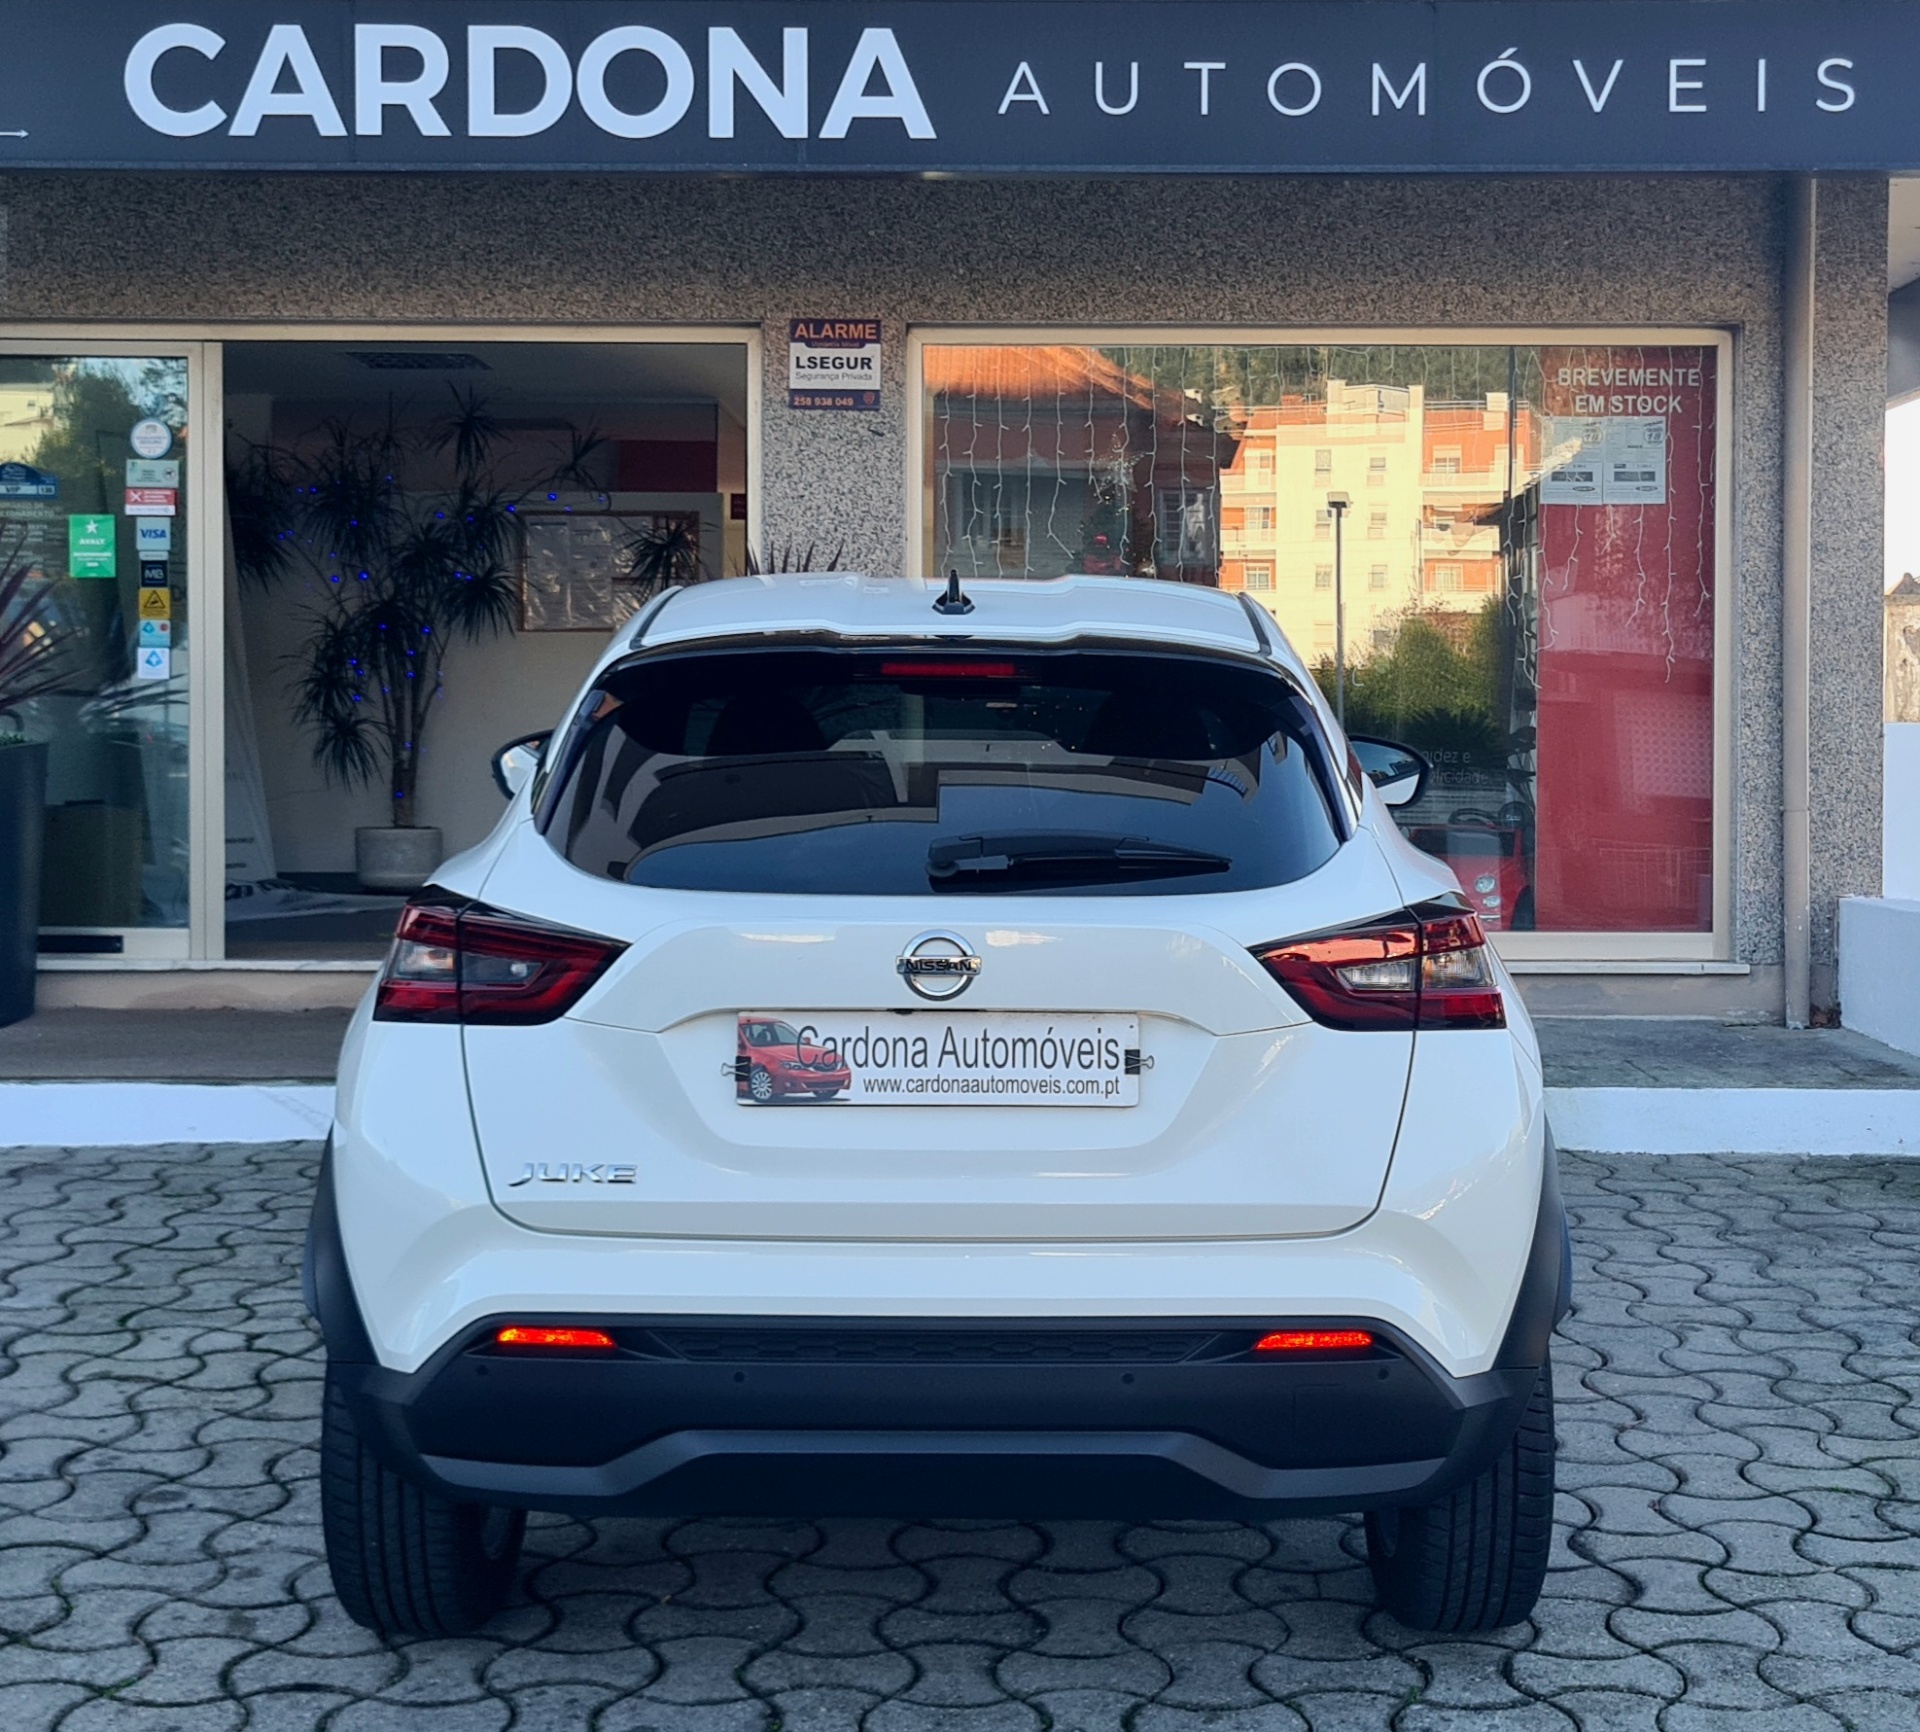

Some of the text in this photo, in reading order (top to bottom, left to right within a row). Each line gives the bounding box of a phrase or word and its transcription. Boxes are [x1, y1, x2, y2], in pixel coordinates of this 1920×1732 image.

[123, 22, 1857, 139] CARDONA AUTOMÓVEIS
[794, 323, 877, 340] ALARME
[795, 356, 873, 370] LSEGUR
[795, 372, 873, 382] Segurança Privada
[1558, 368, 1700, 387] BREVEMENTE
[814, 397, 833, 406] 938
[835, 397, 854, 407] 049
[1575, 395, 1683, 413] EM STOCK
[140, 528, 167, 539] VISA
[144, 568, 165, 580] MB
[1462, 751, 1471, 763] e
[906, 958, 972, 972] NISSAN
[796, 1025, 1119, 1069] Cardona Automóveis
[864, 1073, 1120, 1100] www.cardonaautomoveis.com.pt
[508, 1162, 638, 1187] JUKE
